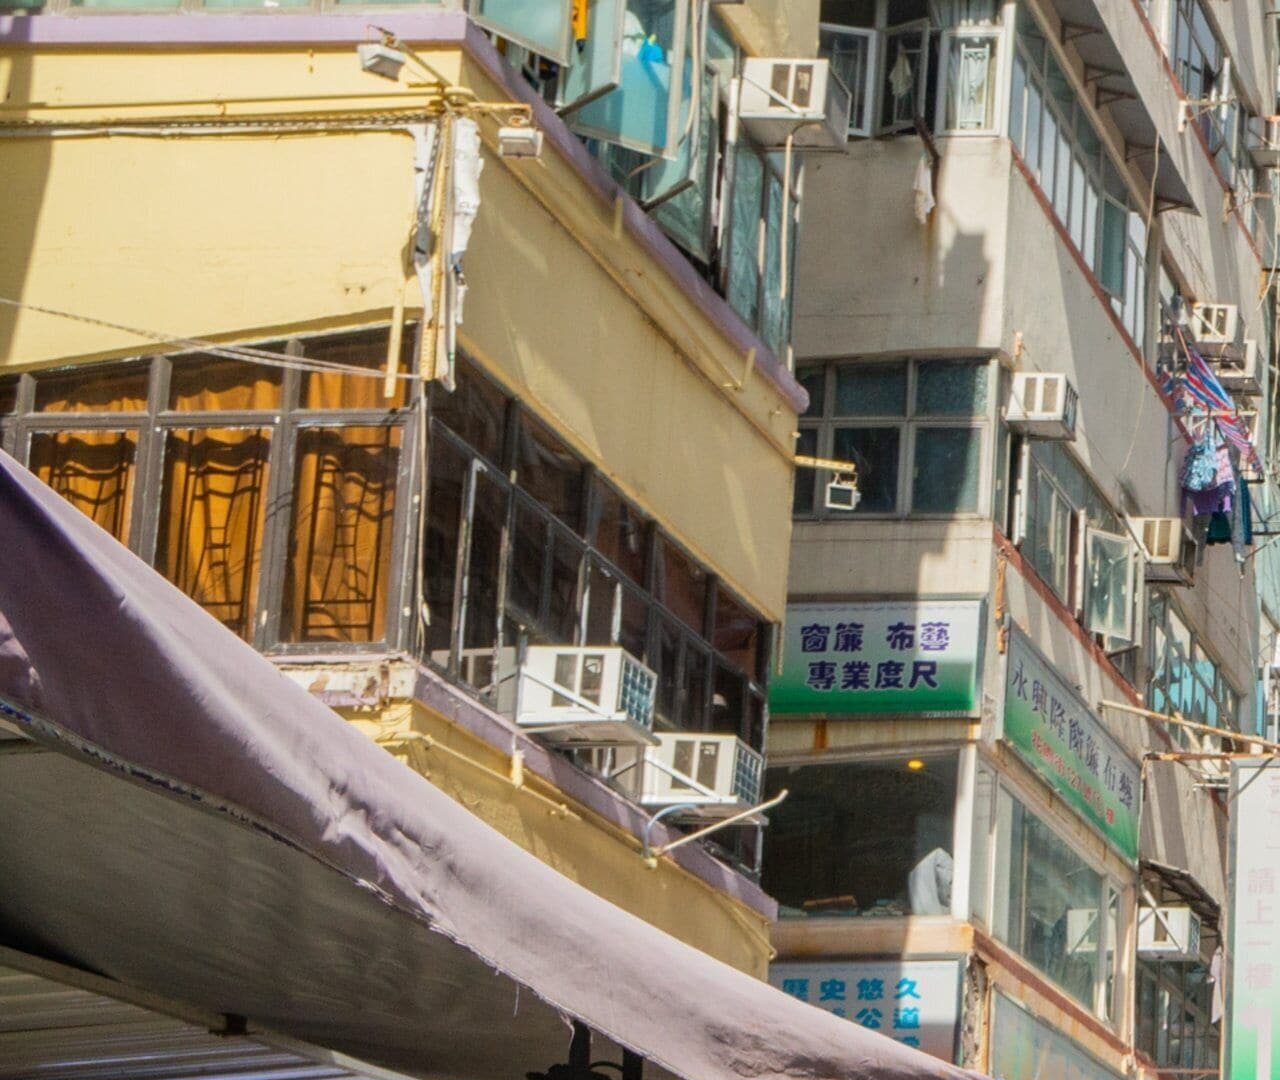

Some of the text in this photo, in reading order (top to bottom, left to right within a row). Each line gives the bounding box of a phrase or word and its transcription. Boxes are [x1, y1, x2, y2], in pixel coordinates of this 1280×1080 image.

[886, 622, 950, 651] 布藝
[806, 661, 938, 689] 專業度尺
